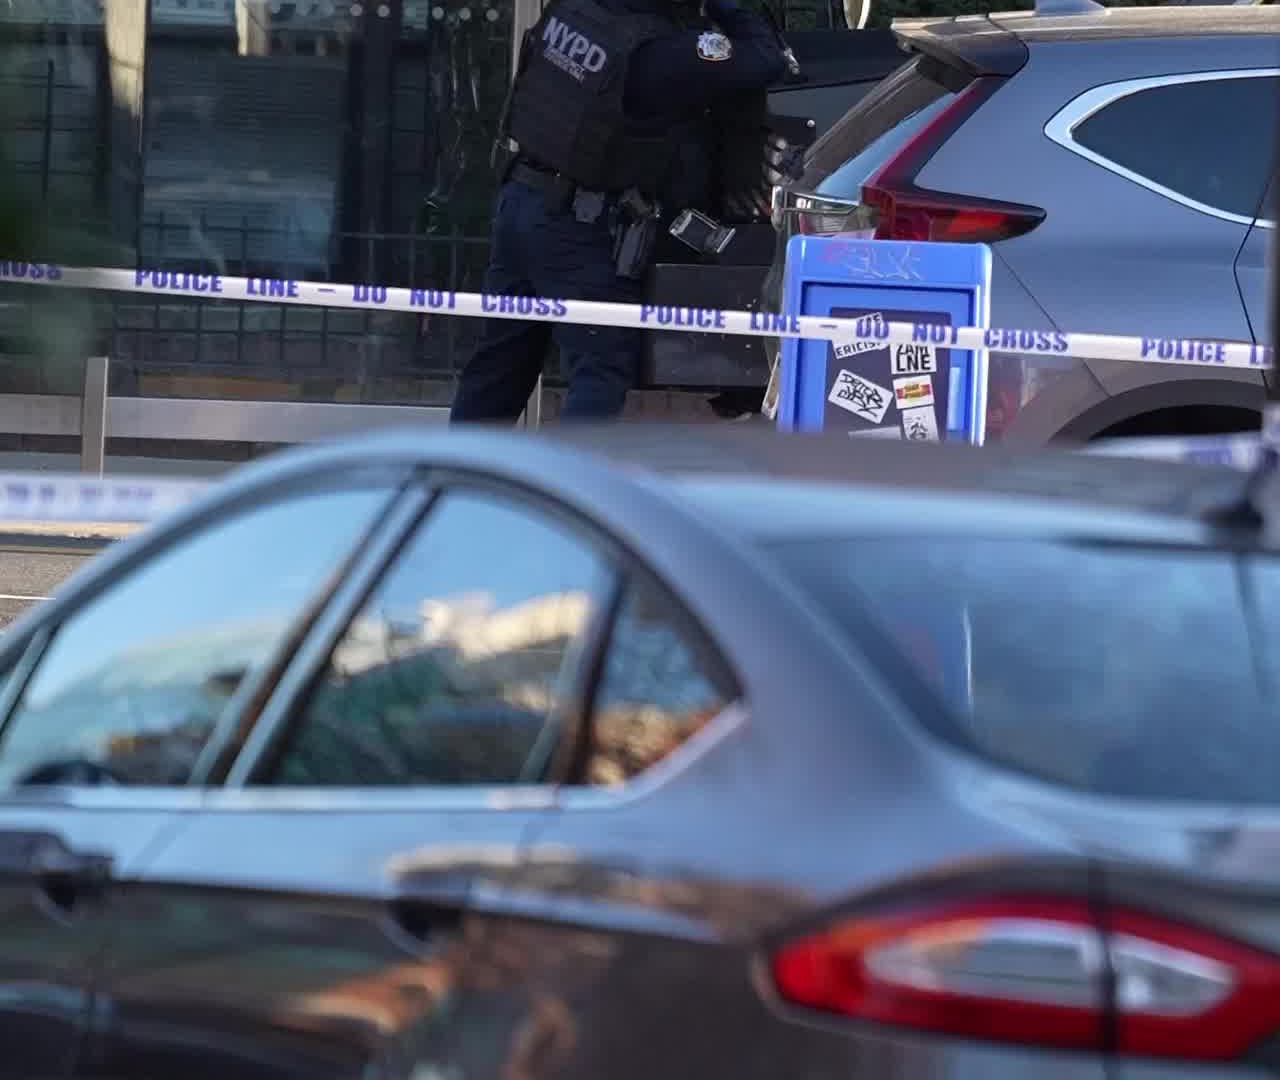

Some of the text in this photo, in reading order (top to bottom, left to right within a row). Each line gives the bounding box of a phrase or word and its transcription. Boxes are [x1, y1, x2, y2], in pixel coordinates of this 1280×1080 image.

[543, 16, 606, 72] NYPD
[135, 270, 223, 293] POLICE
[247, 278, 299, 298] LINE
[352, 284, 387, 304] DO
[410, 288, 455, 309] NOT
[481, 294, 567, 317] CROSS
[640, 305, 725, 329] POLICE
[751, 312, 800, 333] LINE
[856, 318, 889, 339] DO
[912, 322, 958, 344] NOT
[984, 328, 1068, 352] CROSS
[1141, 337, 1225, 363] POLICE
